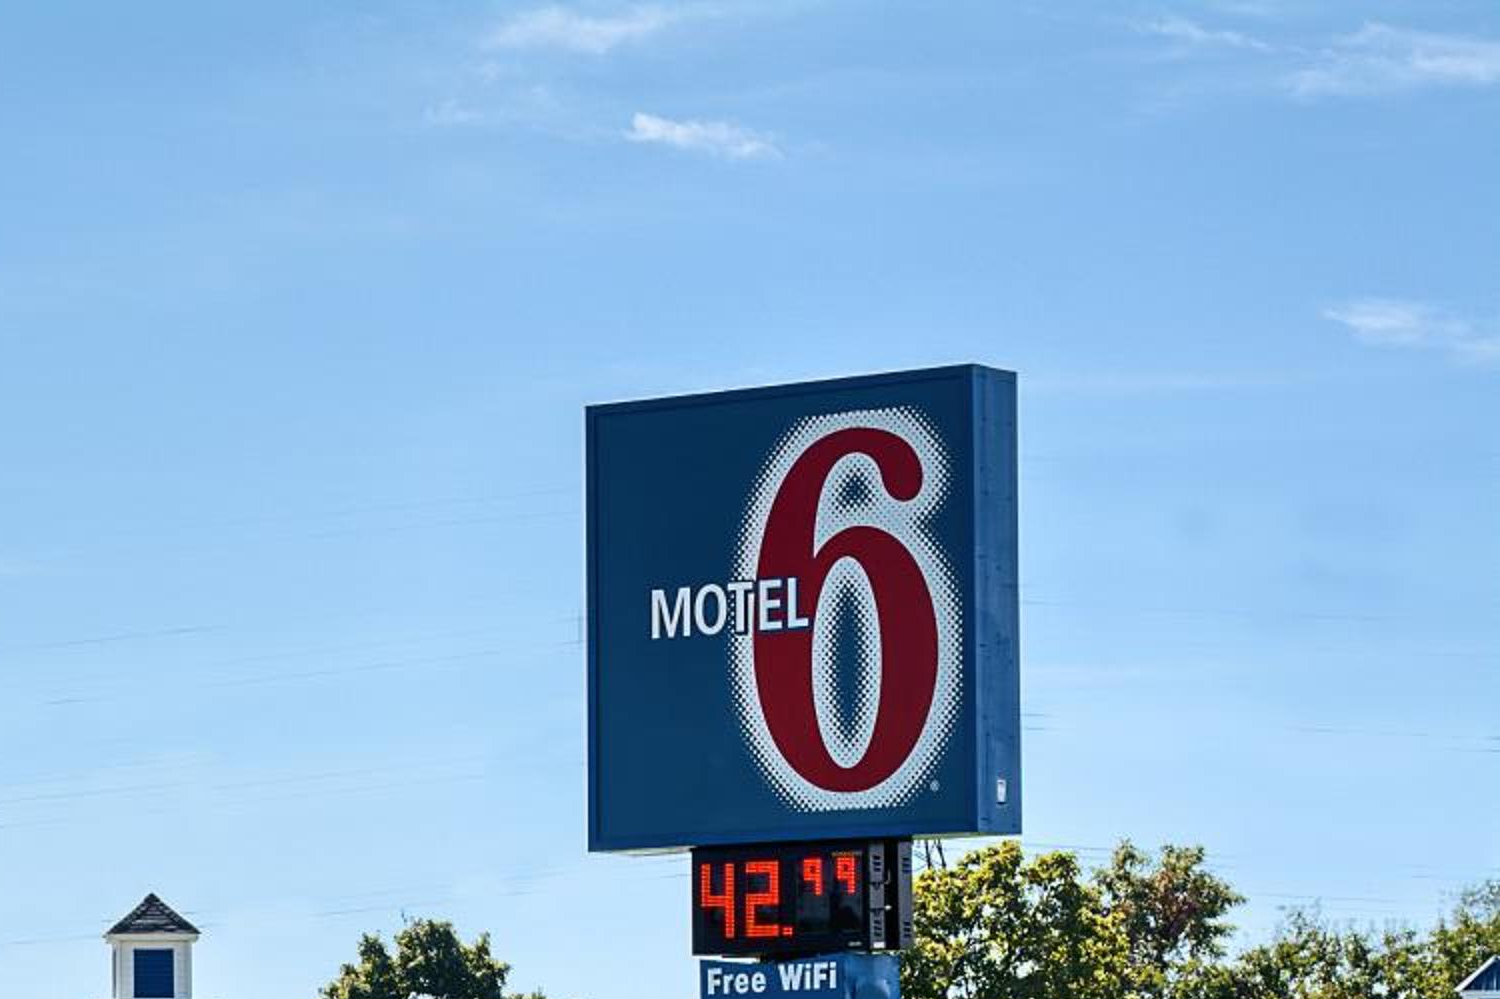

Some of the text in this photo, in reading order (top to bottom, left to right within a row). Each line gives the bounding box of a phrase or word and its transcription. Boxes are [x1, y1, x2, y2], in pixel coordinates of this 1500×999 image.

[650, 426, 939, 794] MOTEL 6
[707, 961, 838, 996] Free WiFi
